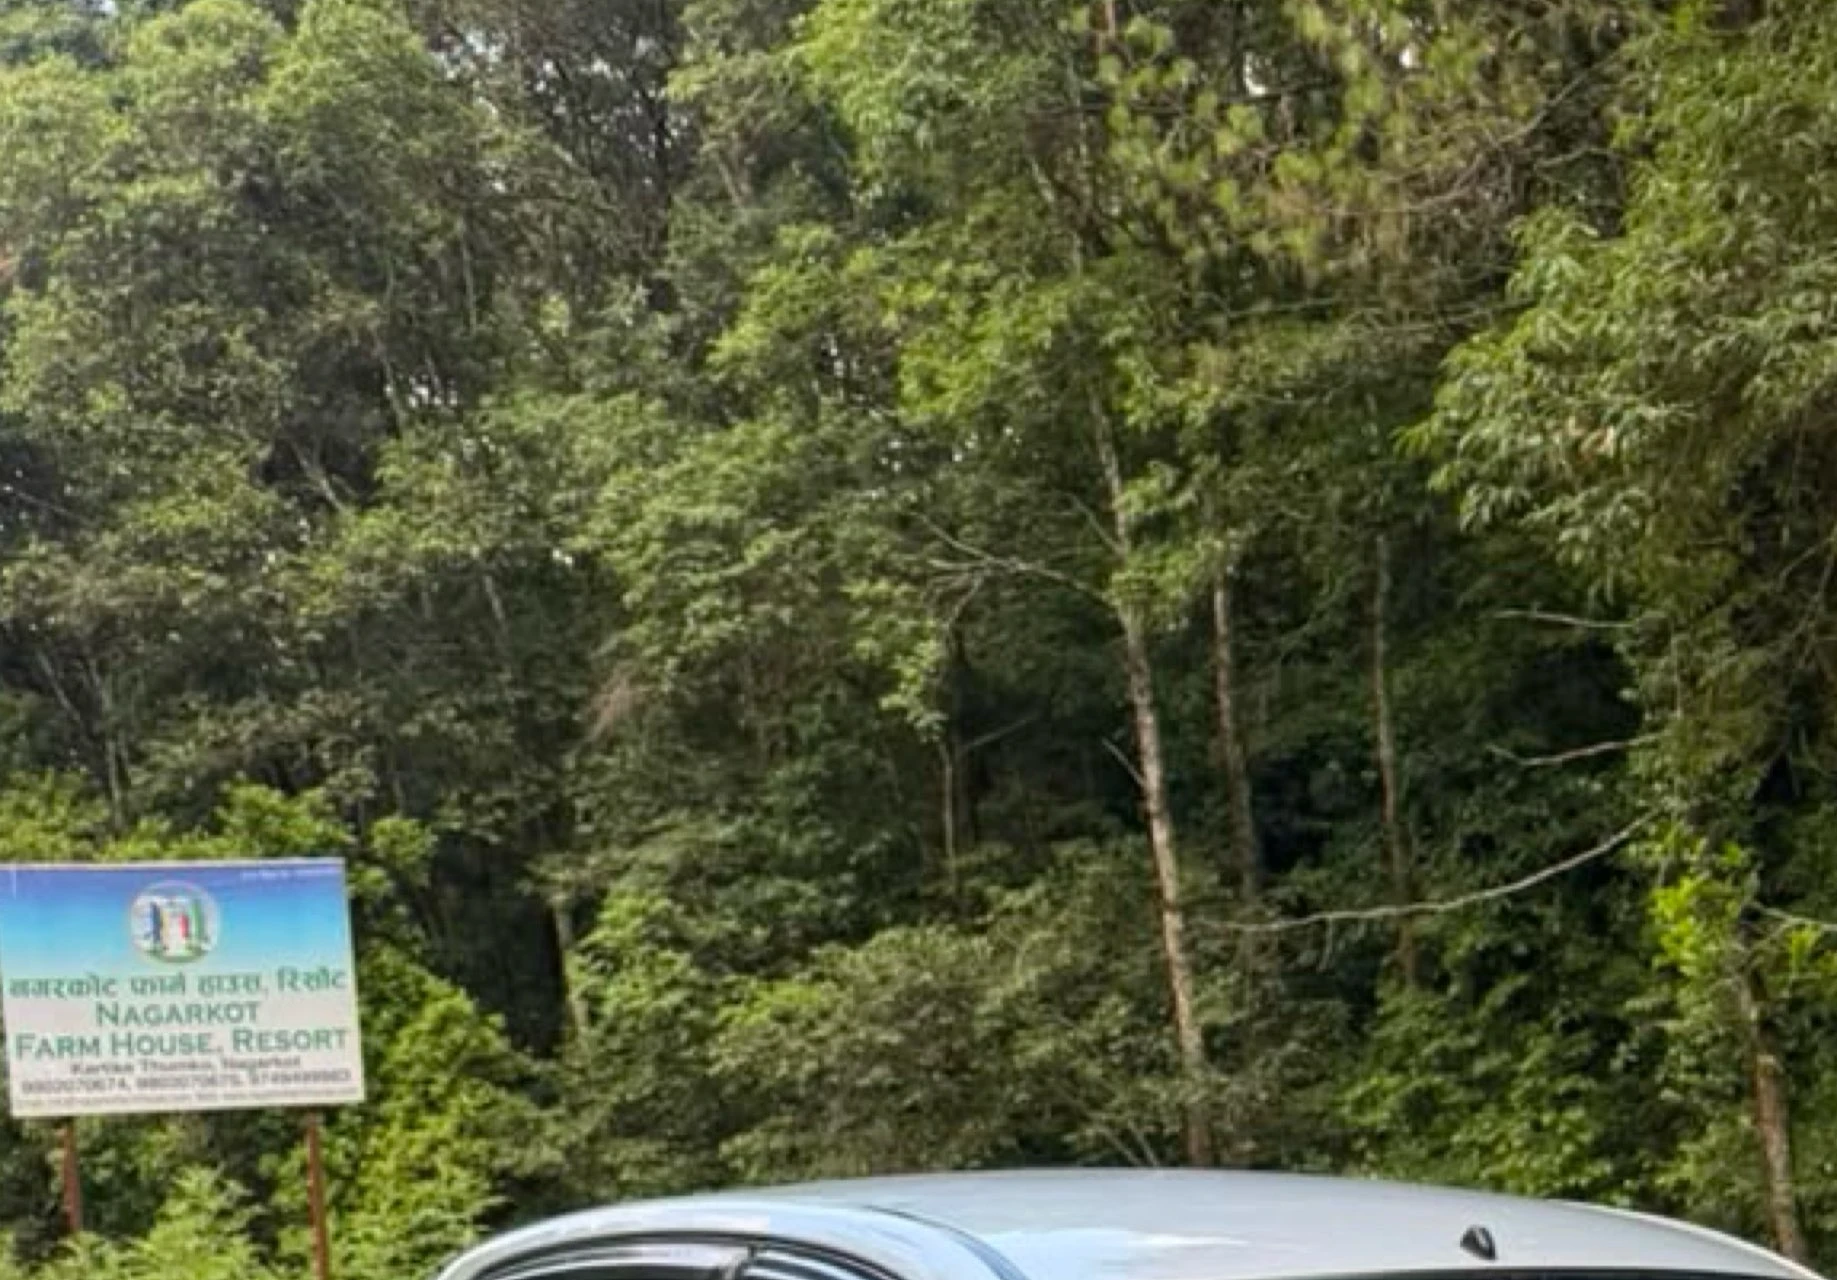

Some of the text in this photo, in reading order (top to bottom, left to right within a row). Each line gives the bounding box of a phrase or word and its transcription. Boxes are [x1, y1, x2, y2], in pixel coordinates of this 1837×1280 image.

[96, 1001, 261, 1026] NAGARKOT
[15, 1033, 100, 1060] FARM
[232, 1028, 348, 1052] RESORT
